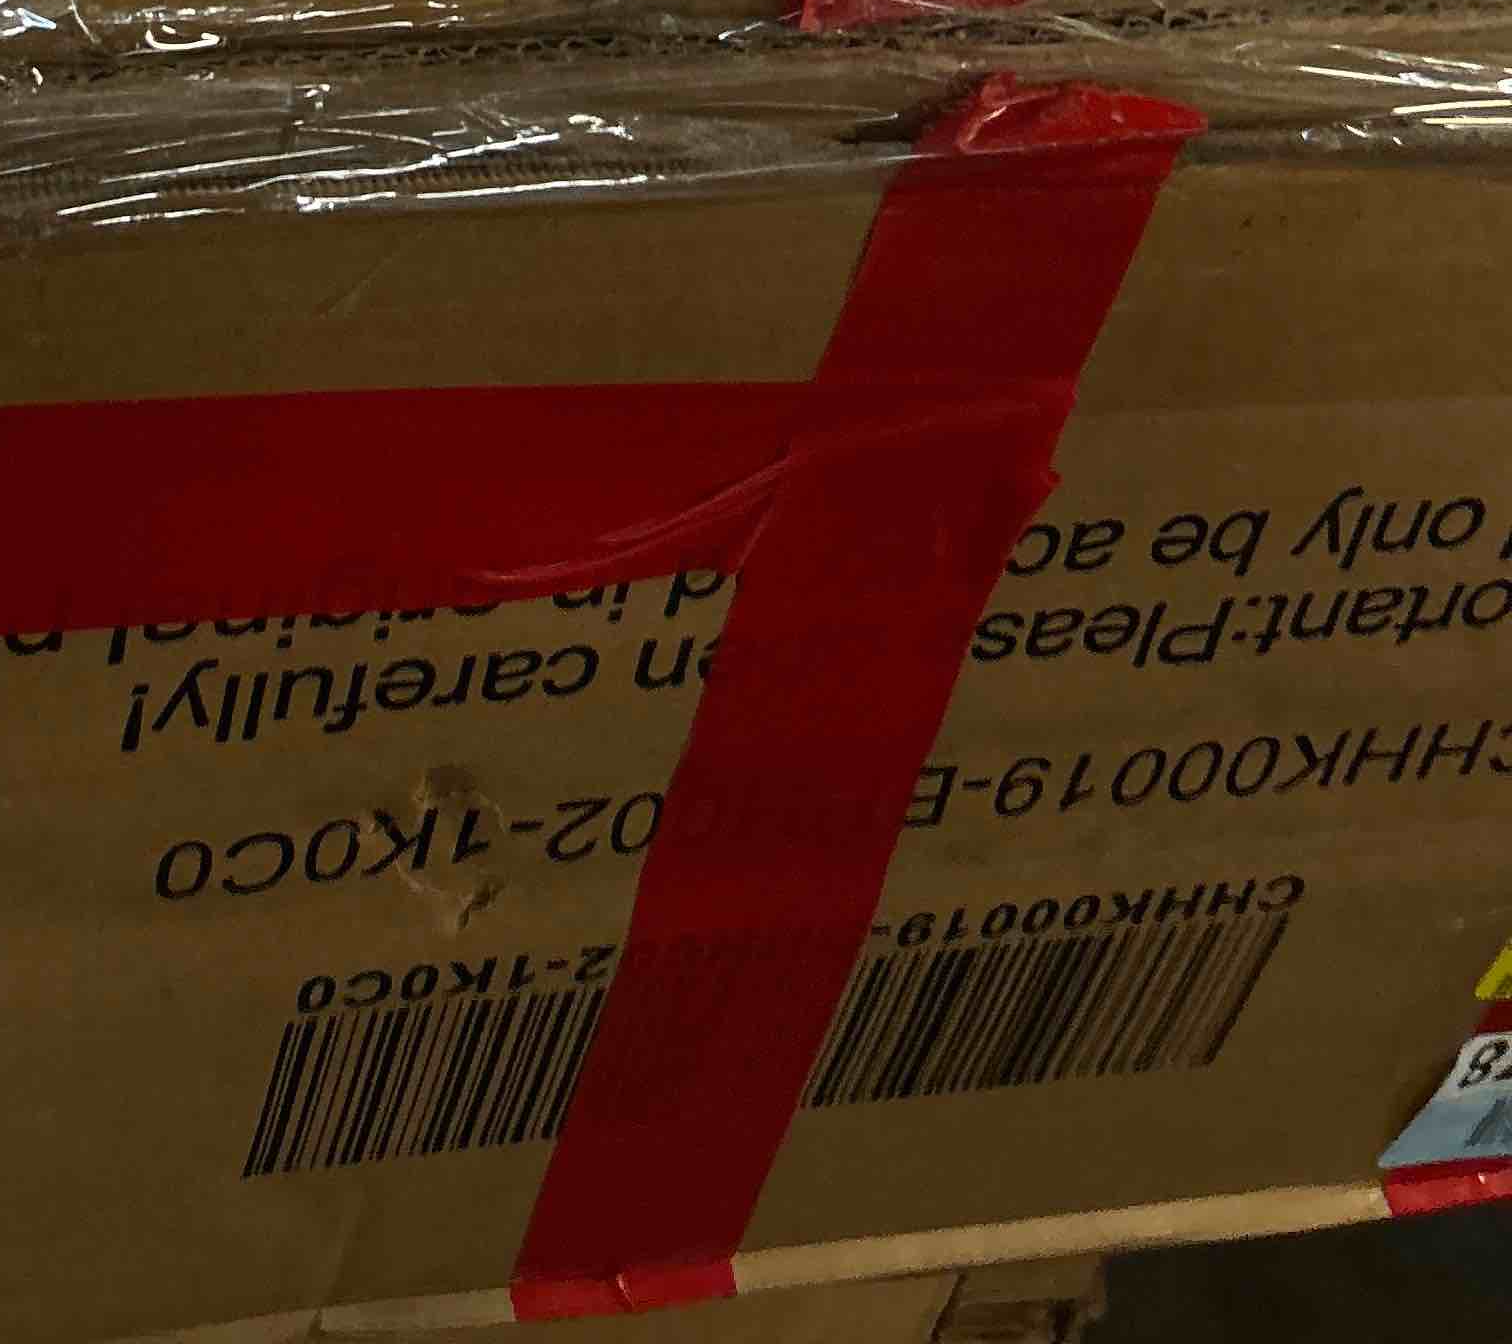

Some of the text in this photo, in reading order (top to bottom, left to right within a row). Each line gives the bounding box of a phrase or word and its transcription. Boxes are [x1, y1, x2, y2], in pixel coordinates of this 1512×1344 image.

[1152, 509, 1271, 577] be
[1290, 485, 1487, 571] only
[121, 643, 600, 752] carefully!
